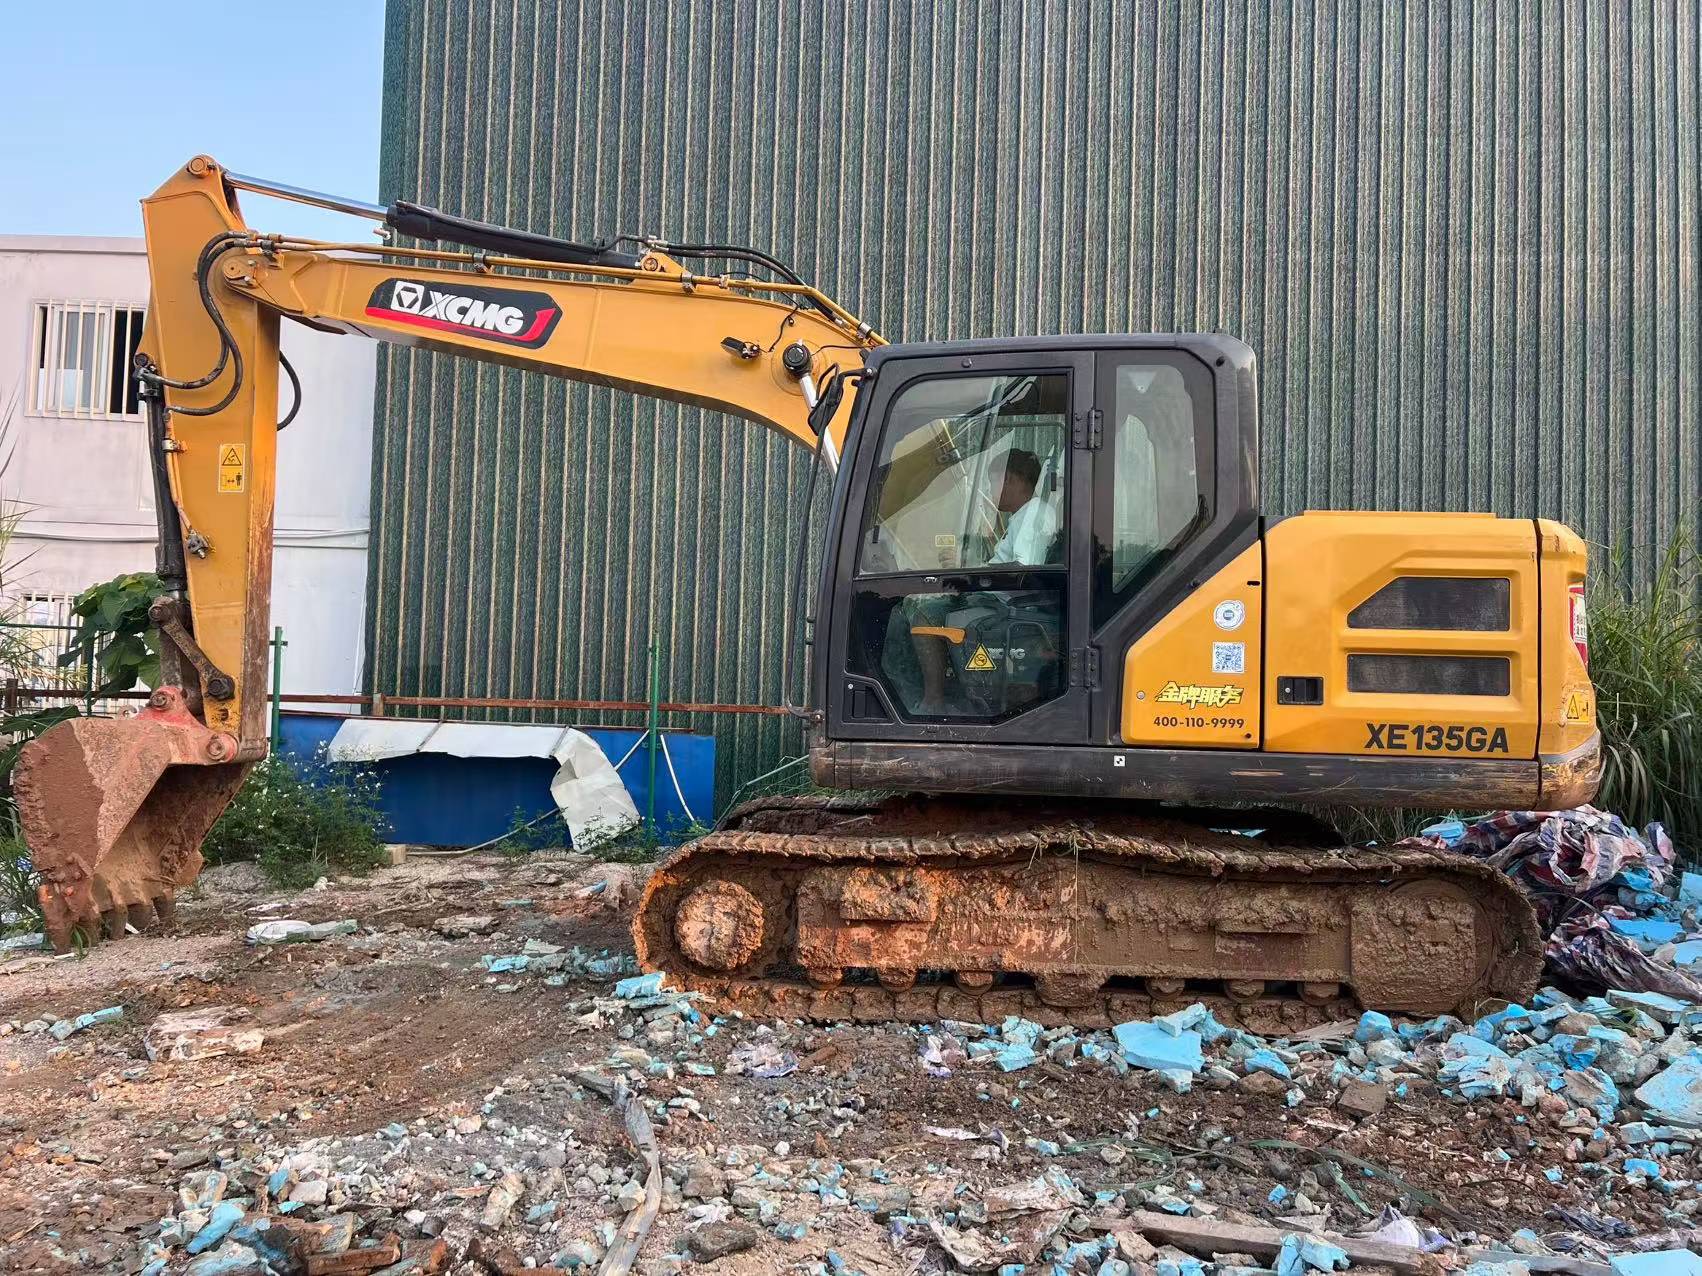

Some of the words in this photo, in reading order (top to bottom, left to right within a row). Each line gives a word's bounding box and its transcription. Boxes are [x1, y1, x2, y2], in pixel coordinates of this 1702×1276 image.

[419, 290, 524, 334] XCMG
[1155, 680, 1244, 709] 金牌服务
[1153, 716, 1245, 729] 400-110-9999
[1364, 723, 1509, 753] XE135GA
